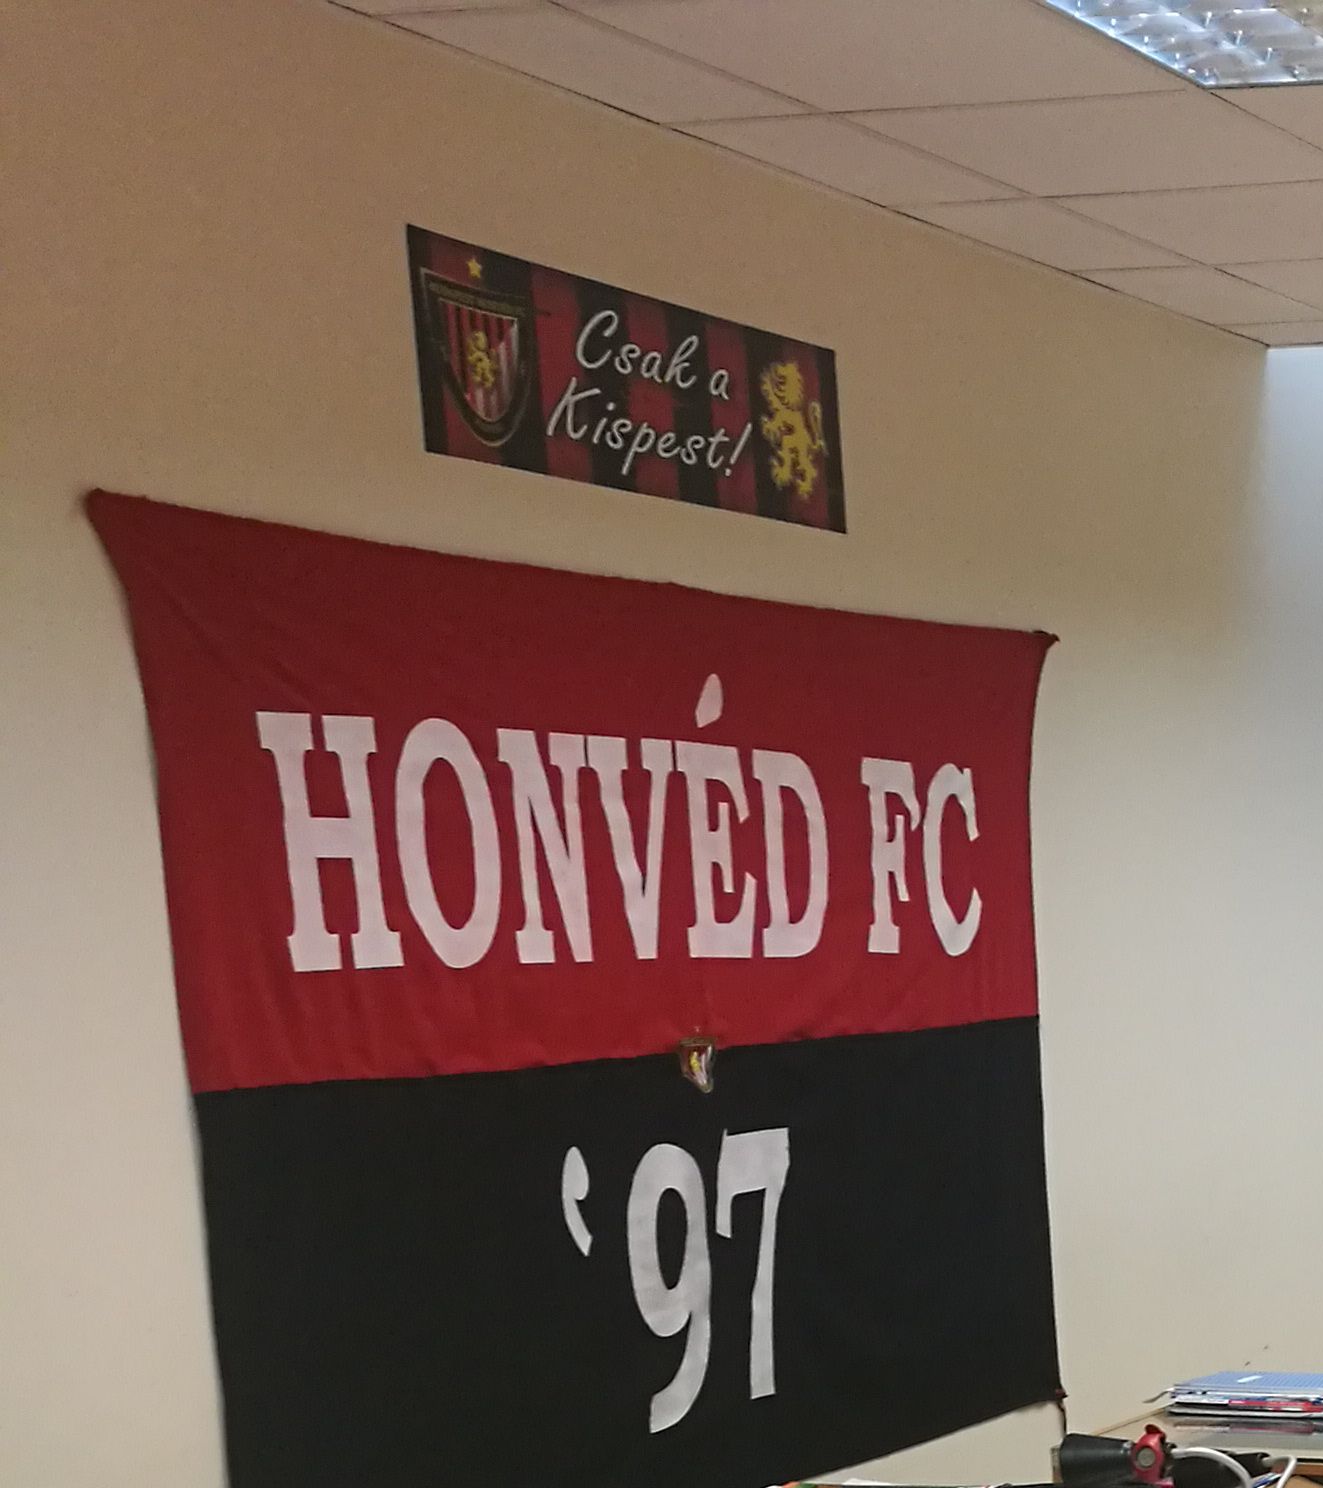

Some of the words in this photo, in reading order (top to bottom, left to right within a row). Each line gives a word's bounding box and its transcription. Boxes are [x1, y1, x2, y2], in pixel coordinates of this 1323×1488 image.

[575, 309, 700, 388] Csak
[709, 369, 729, 400] a
[546, 377, 752, 477] Kispest!
[256, 673, 828, 971] HONVÉD
[861, 757, 982, 957] FC
